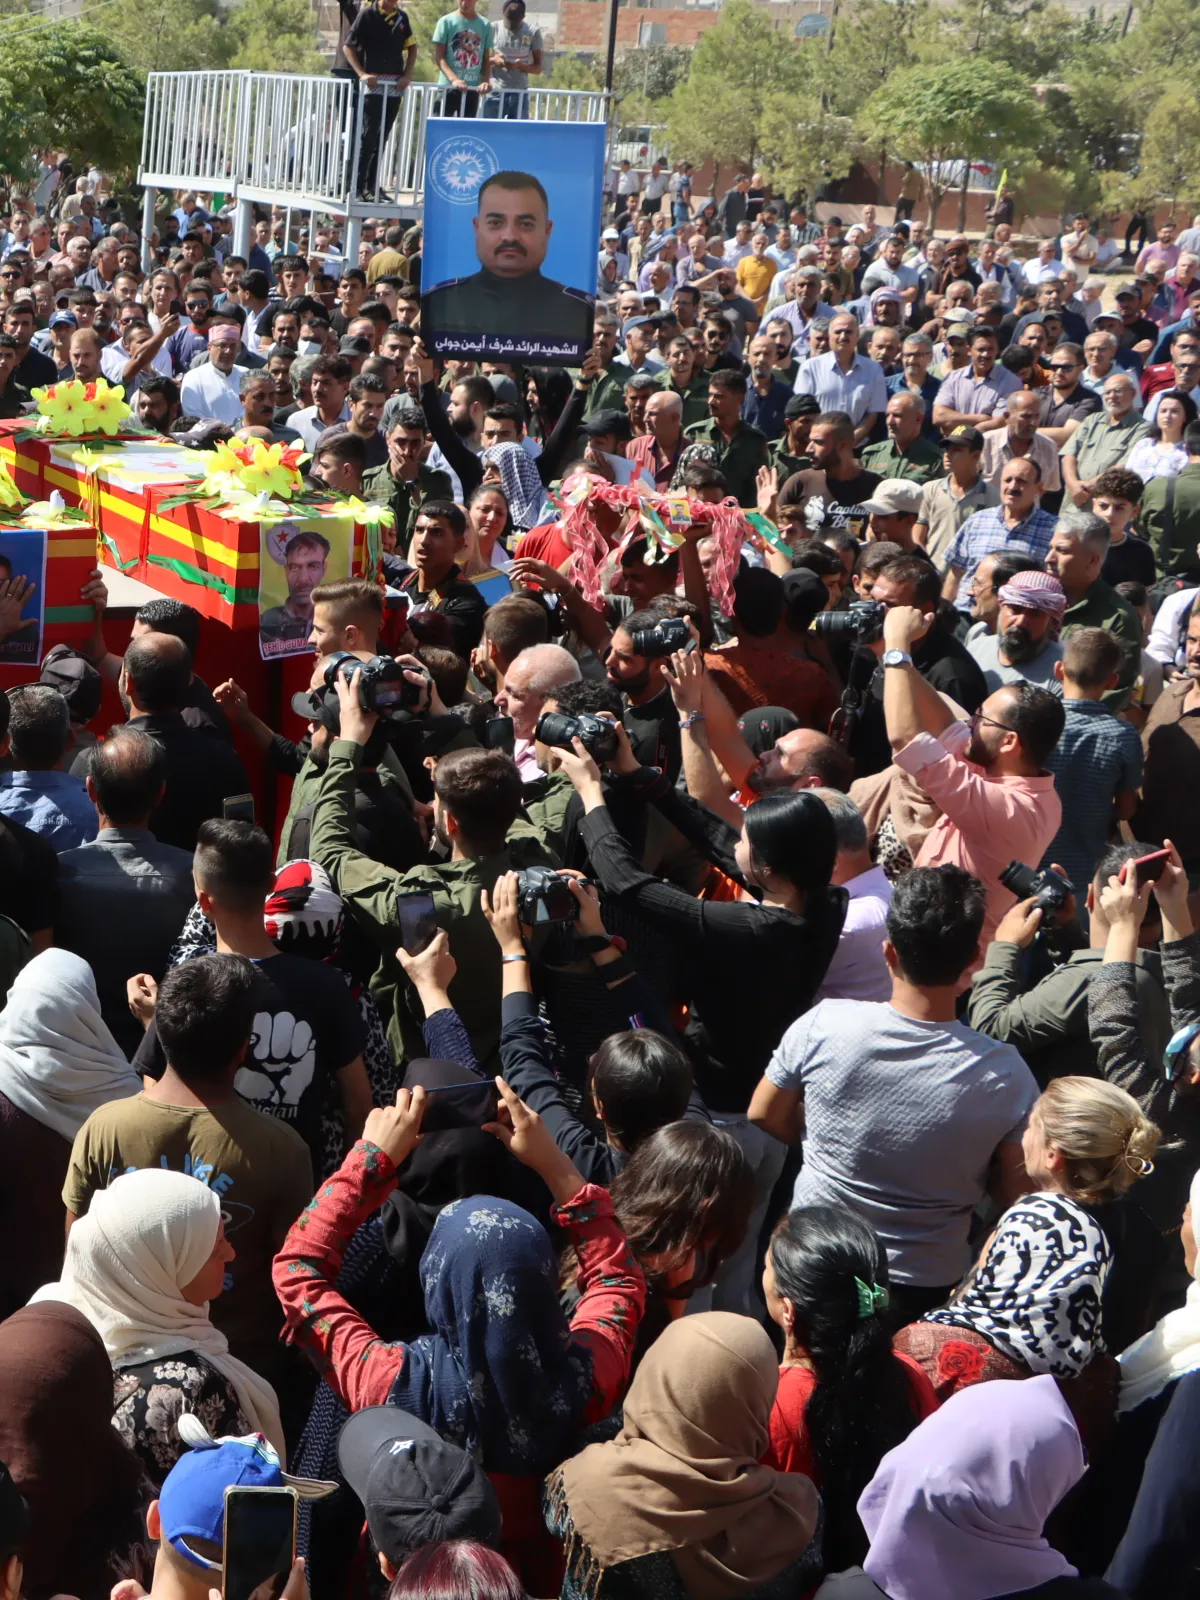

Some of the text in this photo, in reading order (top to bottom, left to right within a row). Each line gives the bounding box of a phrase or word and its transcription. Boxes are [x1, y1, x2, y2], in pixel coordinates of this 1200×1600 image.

[435, 337, 461, 352] جولي
[515, 340, 540, 355] الرائد
[540, 342, 578, 356] الشهيد
